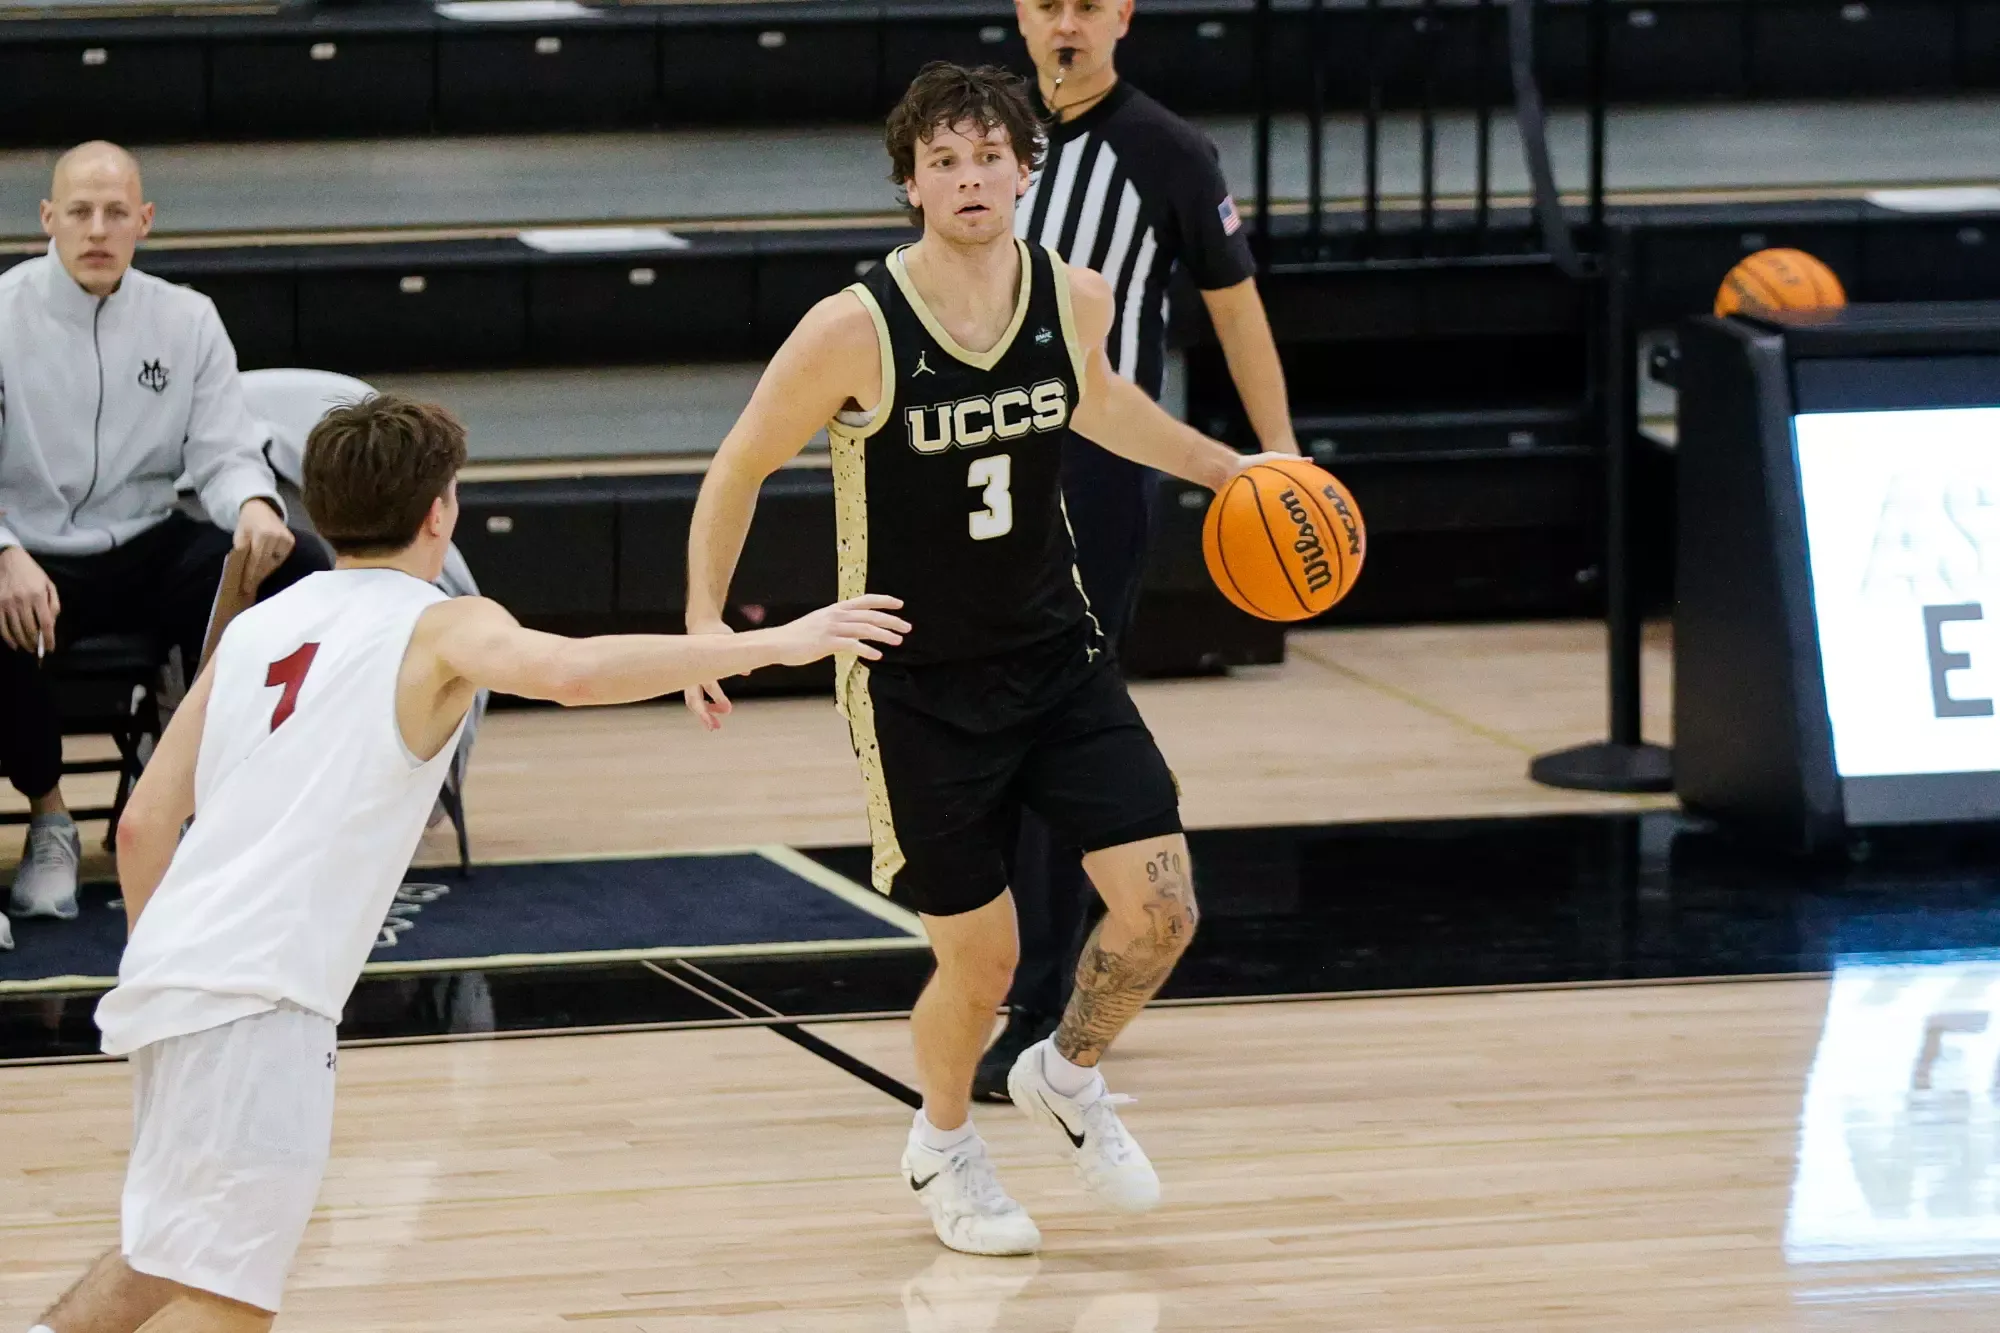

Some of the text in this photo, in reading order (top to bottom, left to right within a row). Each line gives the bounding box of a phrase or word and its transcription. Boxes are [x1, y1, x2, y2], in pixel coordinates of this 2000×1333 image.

[905, 377, 1067, 455] UCCS
[967, 453, 1013, 541] 3
[1279, 489, 1333, 594] Wilson
[264, 641, 321, 735] 1
[1921, 602, 1995, 719] E
[1146, 849, 1181, 883] 970
